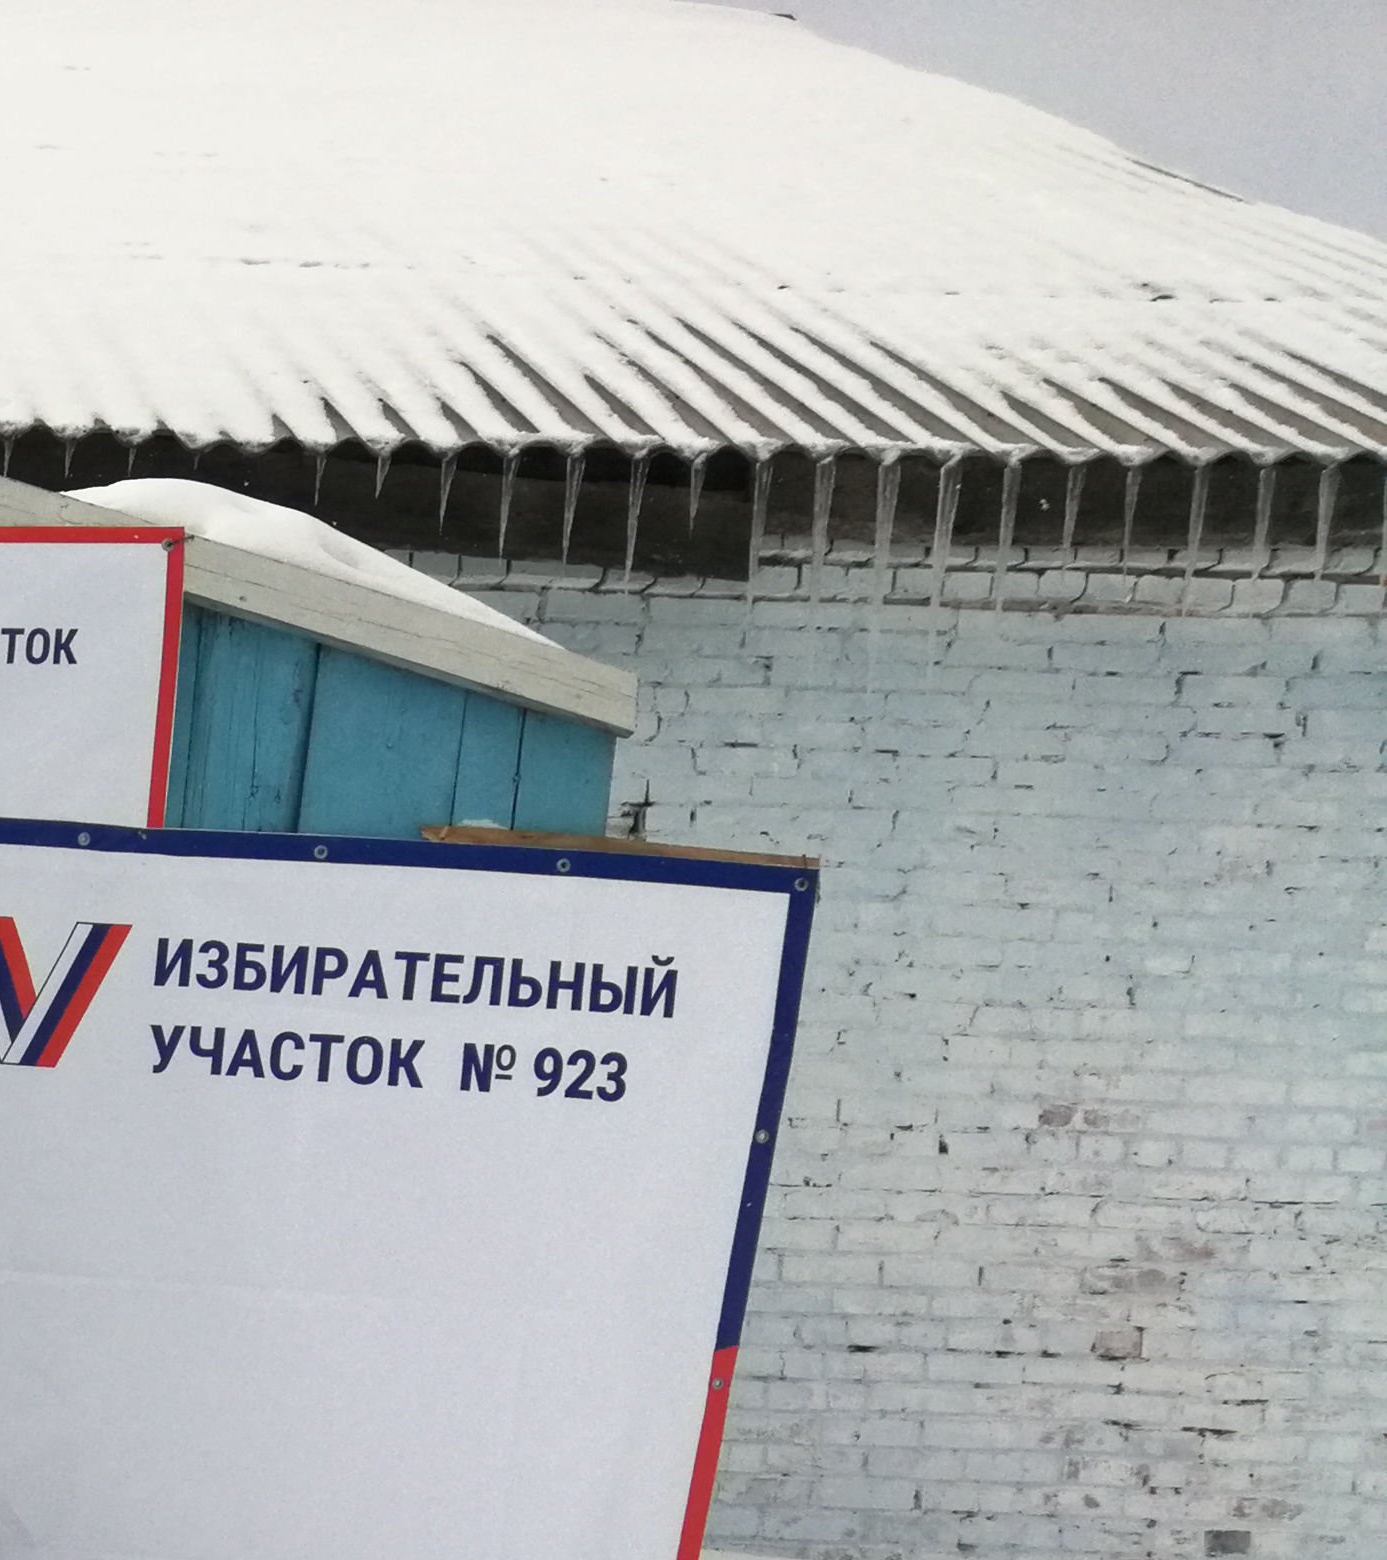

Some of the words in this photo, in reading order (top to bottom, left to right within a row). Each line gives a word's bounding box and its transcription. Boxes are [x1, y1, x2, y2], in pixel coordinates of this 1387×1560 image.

[153, 937, 679, 1018] ИЗБИРАТЕЛЬНЫЙ
[149, 1025, 425, 1089] УЧАСТОК
[459, 1042, 516, 1093] №
[533, 1047, 628, 1102] 923
